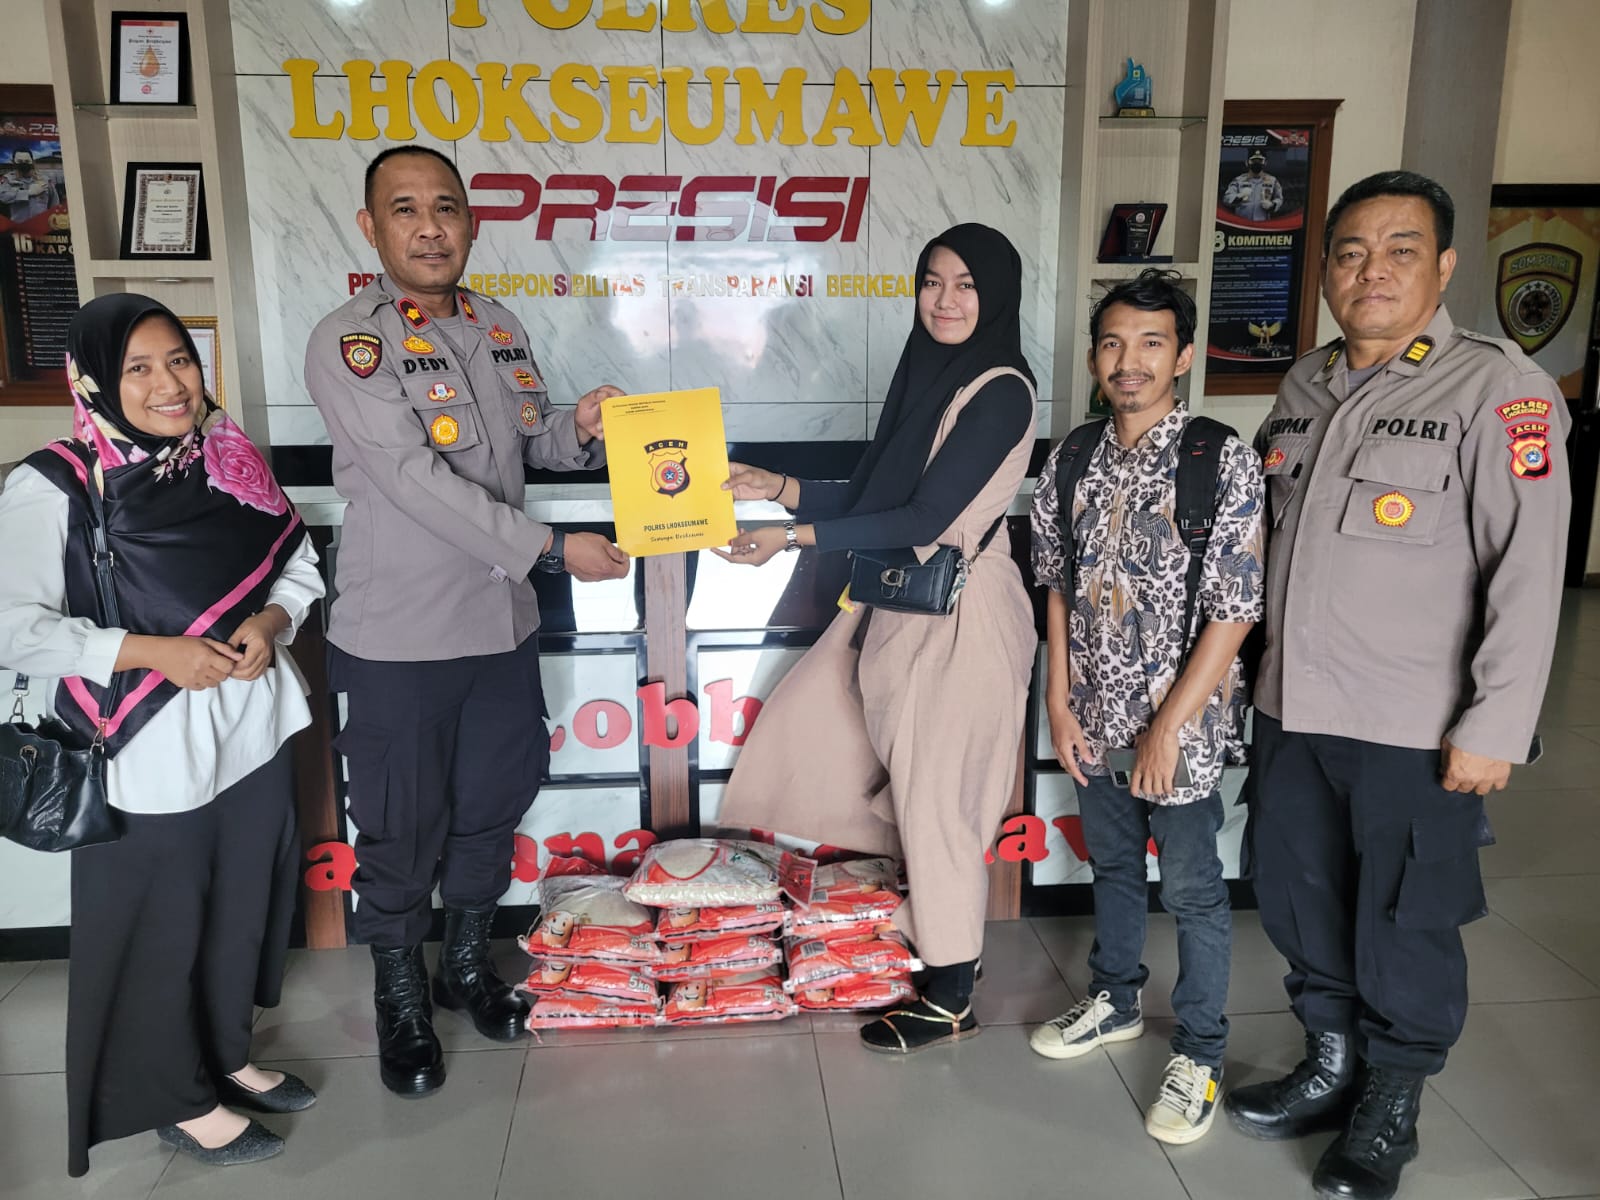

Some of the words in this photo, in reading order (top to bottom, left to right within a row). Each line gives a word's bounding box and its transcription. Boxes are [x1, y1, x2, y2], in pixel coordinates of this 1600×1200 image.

[282, 59, 1017, 147] LHOKSEUMAWE
[1220, 135, 1269, 145] RESISI
[469, 173, 870, 243] PRESISI
[11, 232, 34, 254] 16
[1228, 235, 1293, 247] KOMITMEN
[469, 273, 646, 297] RESPONSIBILITAS
[658, 274, 813, 297] TRANSPARANSI
[491, 347, 528, 363] POLRI
[403, 357, 450, 374] DEDY
[1502, 401, 1548, 415] POLRES
[1371, 418, 1448, 441] POLRI
[1515, 424, 1545, 434] ACEH
[648, 441, 685, 451] ACEH
[644, 523, 666, 533] POLRES
[666, 518, 709, 530] LHOKSEUMAWE
[550, 677, 764, 753] obb
